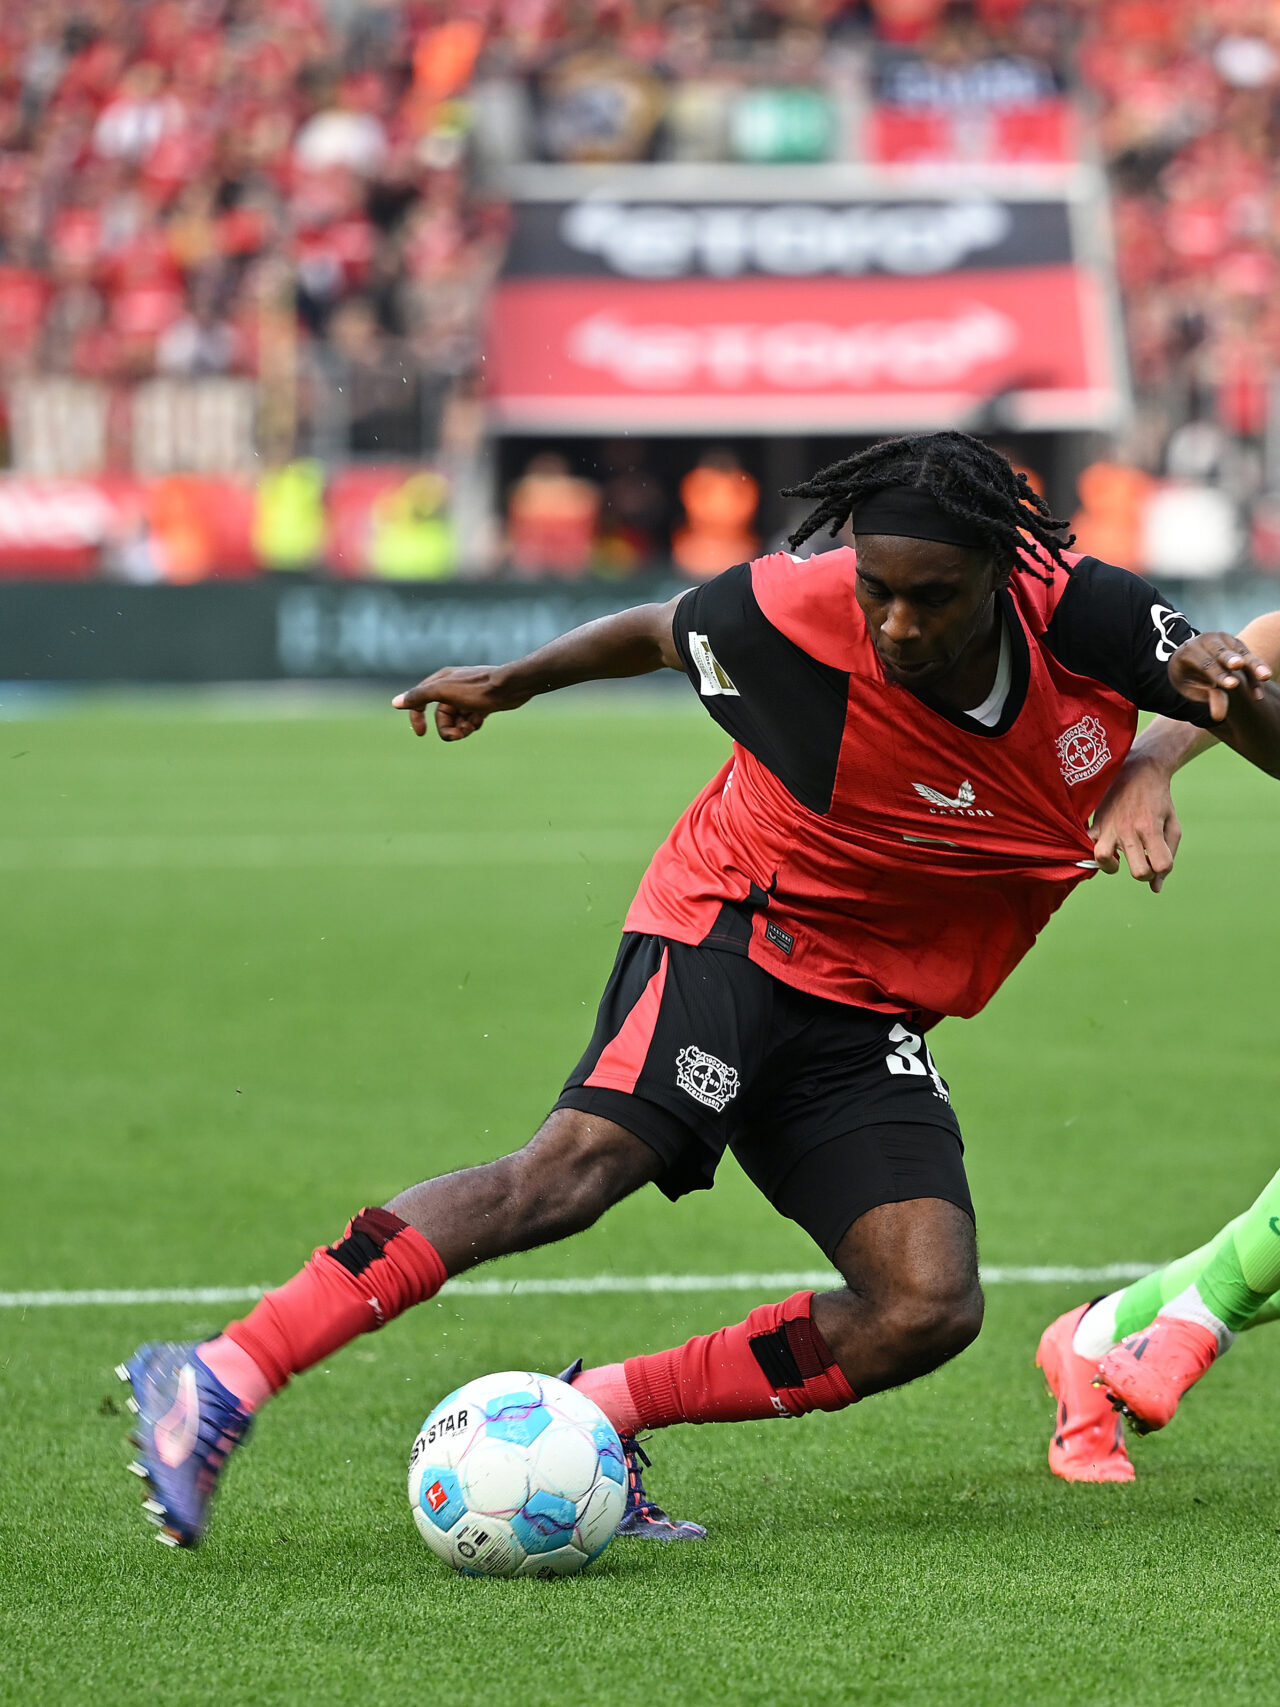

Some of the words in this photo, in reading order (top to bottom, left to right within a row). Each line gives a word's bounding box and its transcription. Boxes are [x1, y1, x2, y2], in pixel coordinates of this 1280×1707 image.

[1064, 728, 1078, 742] 1904
[1069, 753, 1108, 782] Leverkusen
[680, 1079, 720, 1108] Leverkusen
